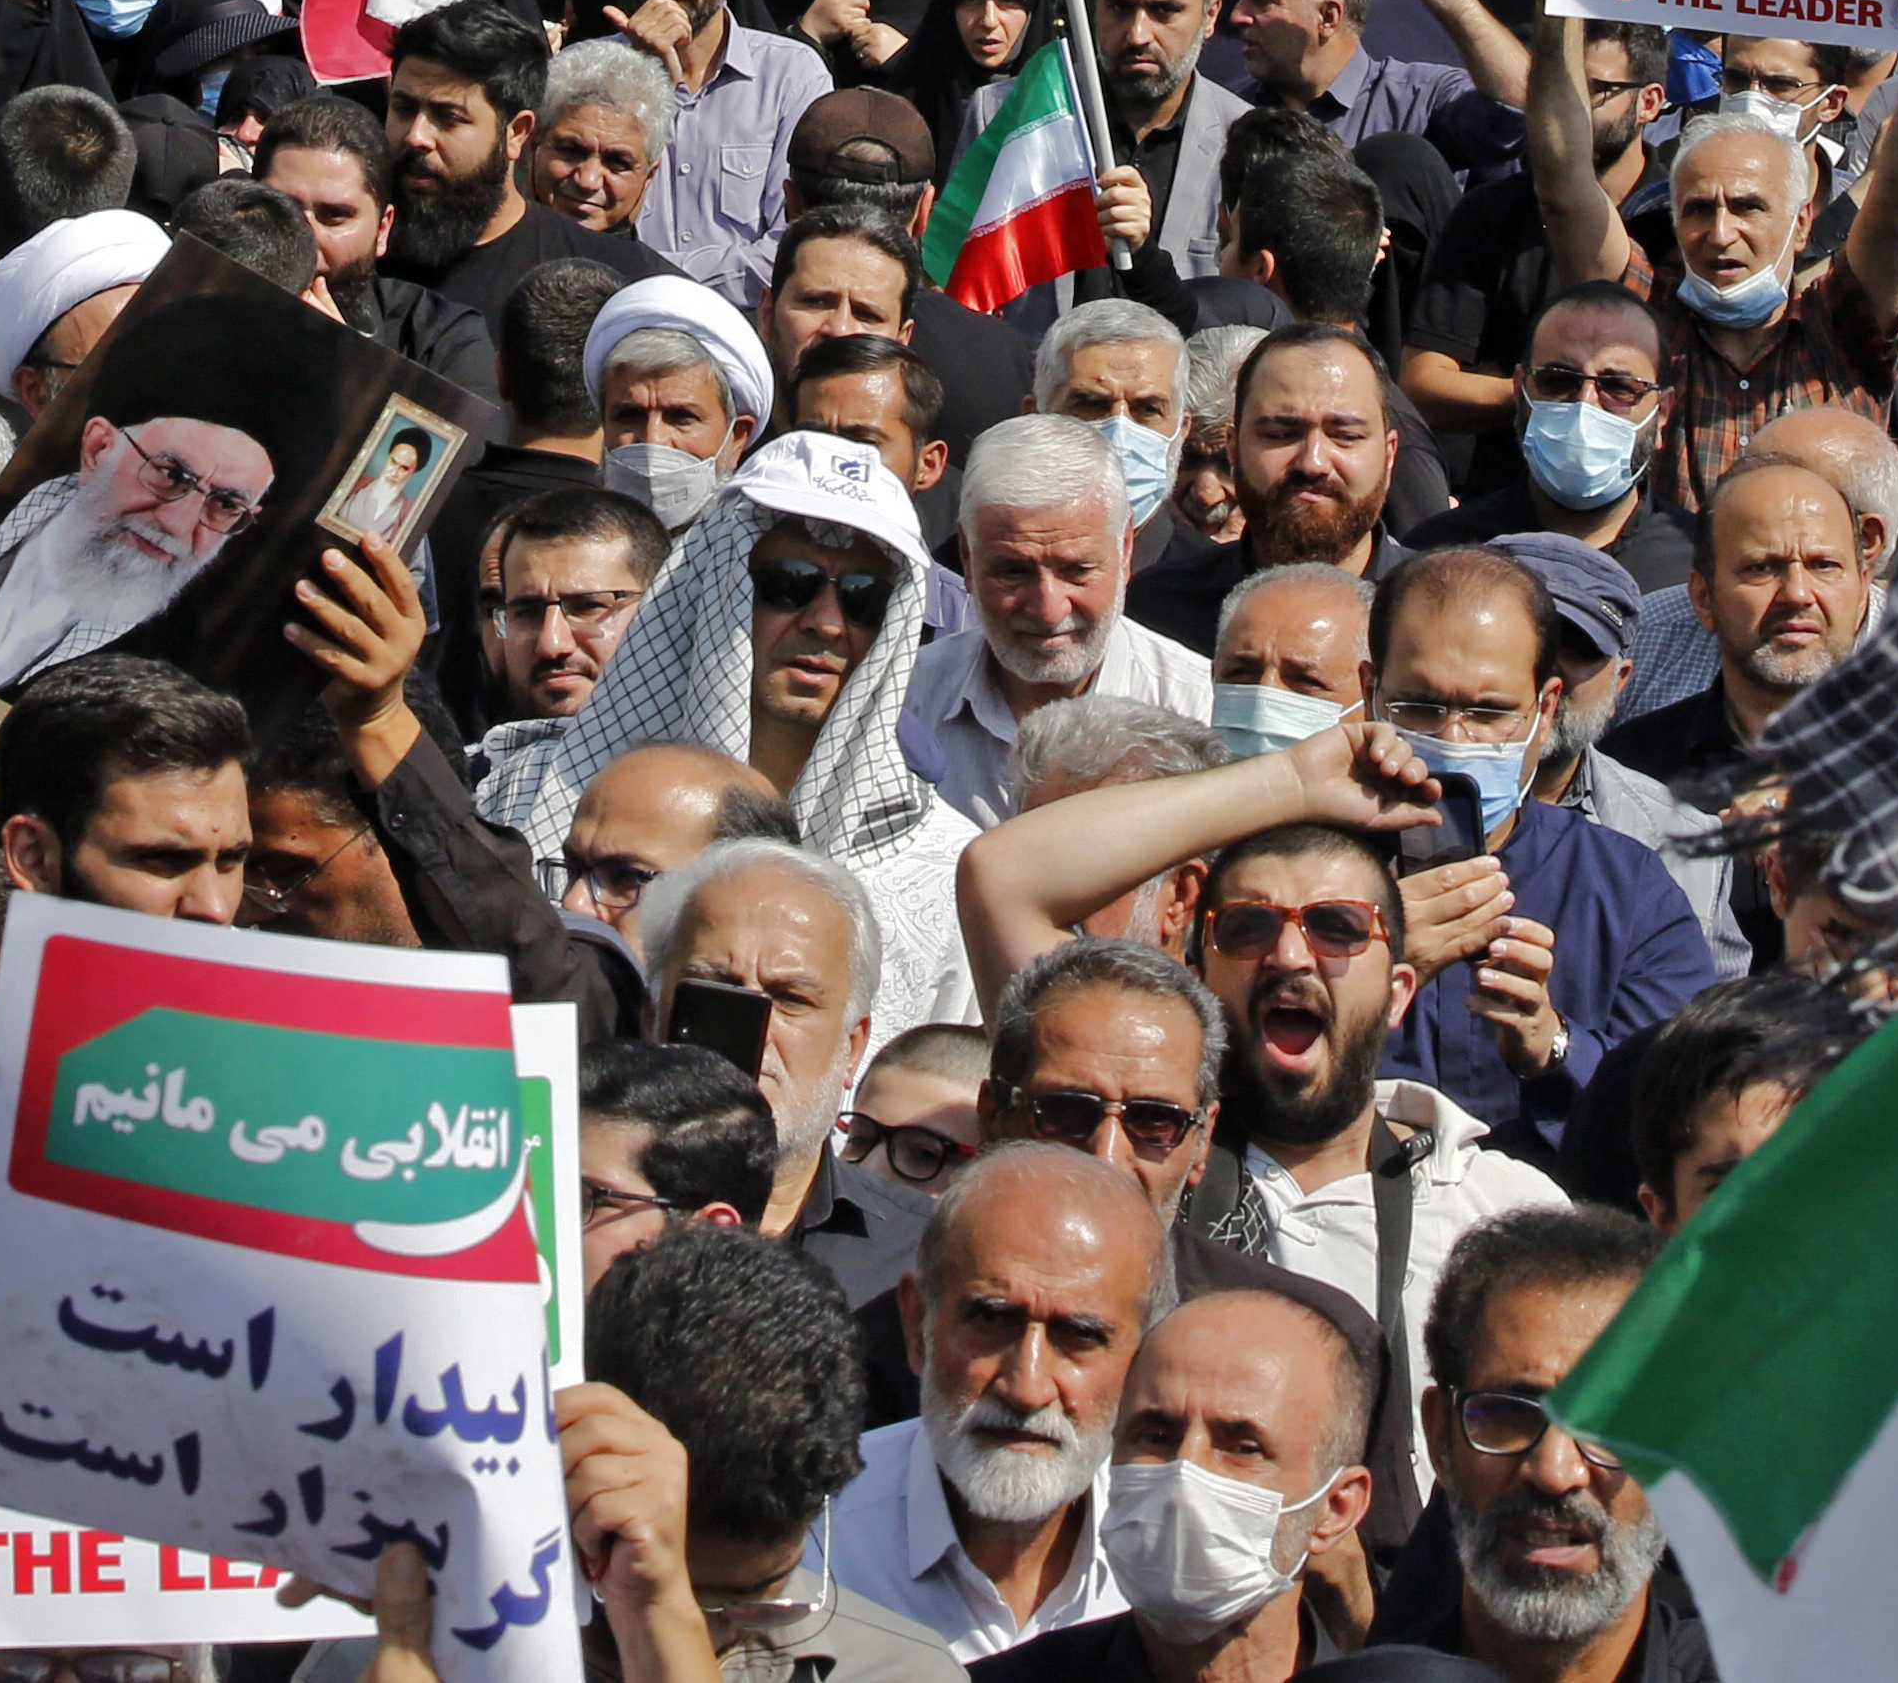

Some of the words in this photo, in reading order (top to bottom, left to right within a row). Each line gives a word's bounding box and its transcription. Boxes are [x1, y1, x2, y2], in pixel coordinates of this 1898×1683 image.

[72, 1067, 216, 1136] مانیم
[228, 1110, 327, 1165] می
[340, 1101, 510, 1182] انقلابی
[58, 1285, 276, 1393] است
[299, 1331, 526, 1474] بیدار
[450, 1525, 562, 1650] گر
